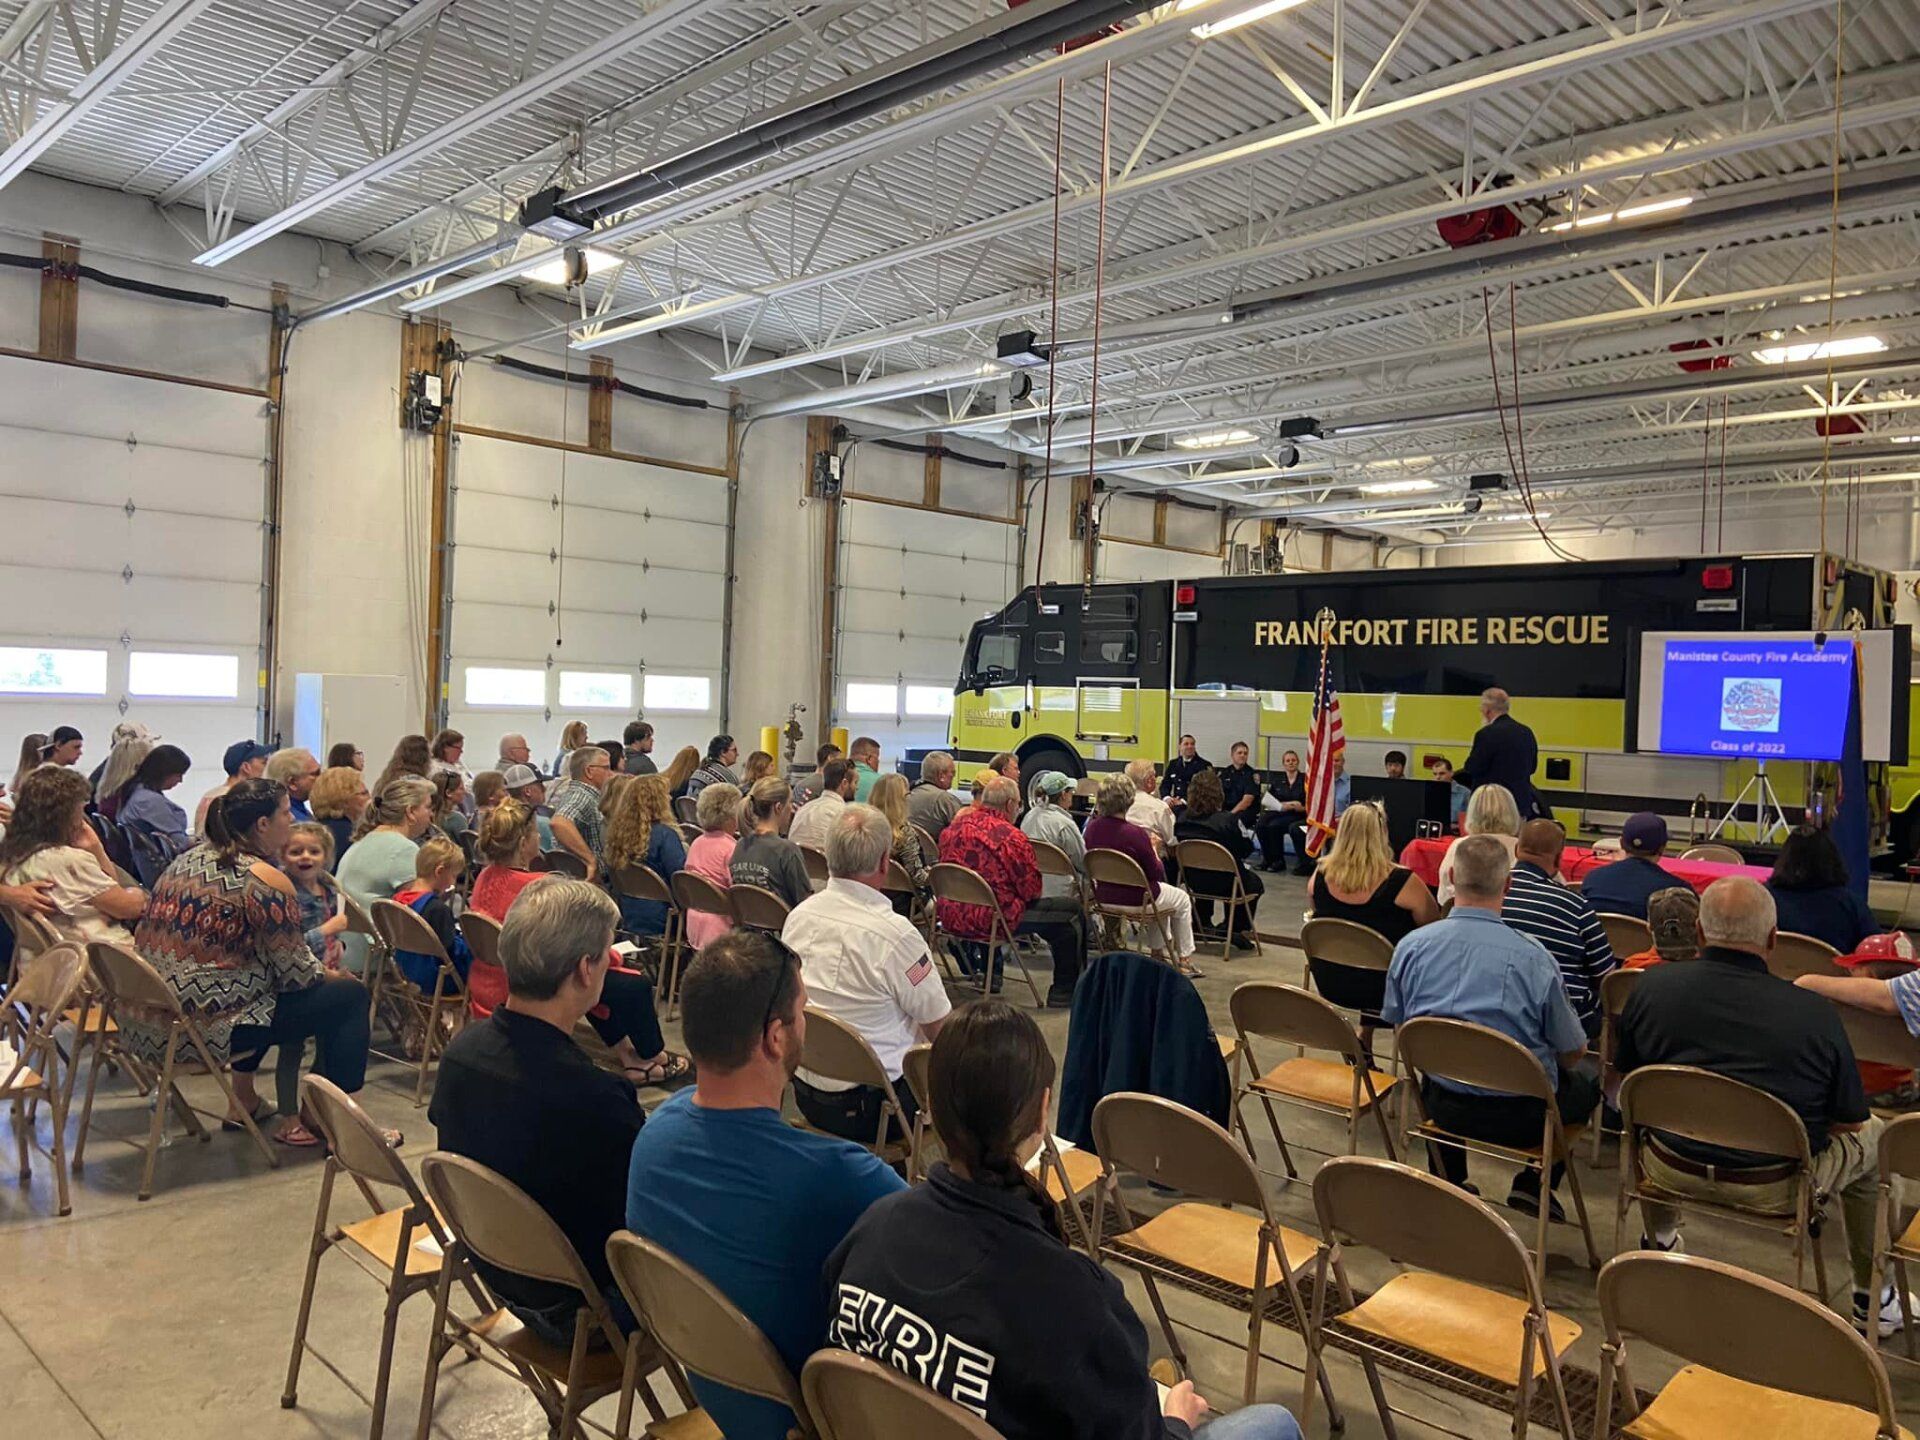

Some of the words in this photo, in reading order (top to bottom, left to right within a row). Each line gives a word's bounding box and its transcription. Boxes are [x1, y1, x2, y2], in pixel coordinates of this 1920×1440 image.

[1255, 619, 1409, 646] FRANKFORT
[1415, 617, 1479, 646] FIRE
[1486, 615, 1610, 645] RESCUE
[1668, 651, 1719, 662] Manistee
[1722, 651, 1763, 664] County
[1766, 652, 1788, 662] Fire
[1791, 652, 1848, 664] Academy
[1711, 741, 1739, 752] Class
[1742, 742, 1755, 752] of
[1757, 743, 1786, 754] 2022
[831, 1283, 995, 1421] FIRE
